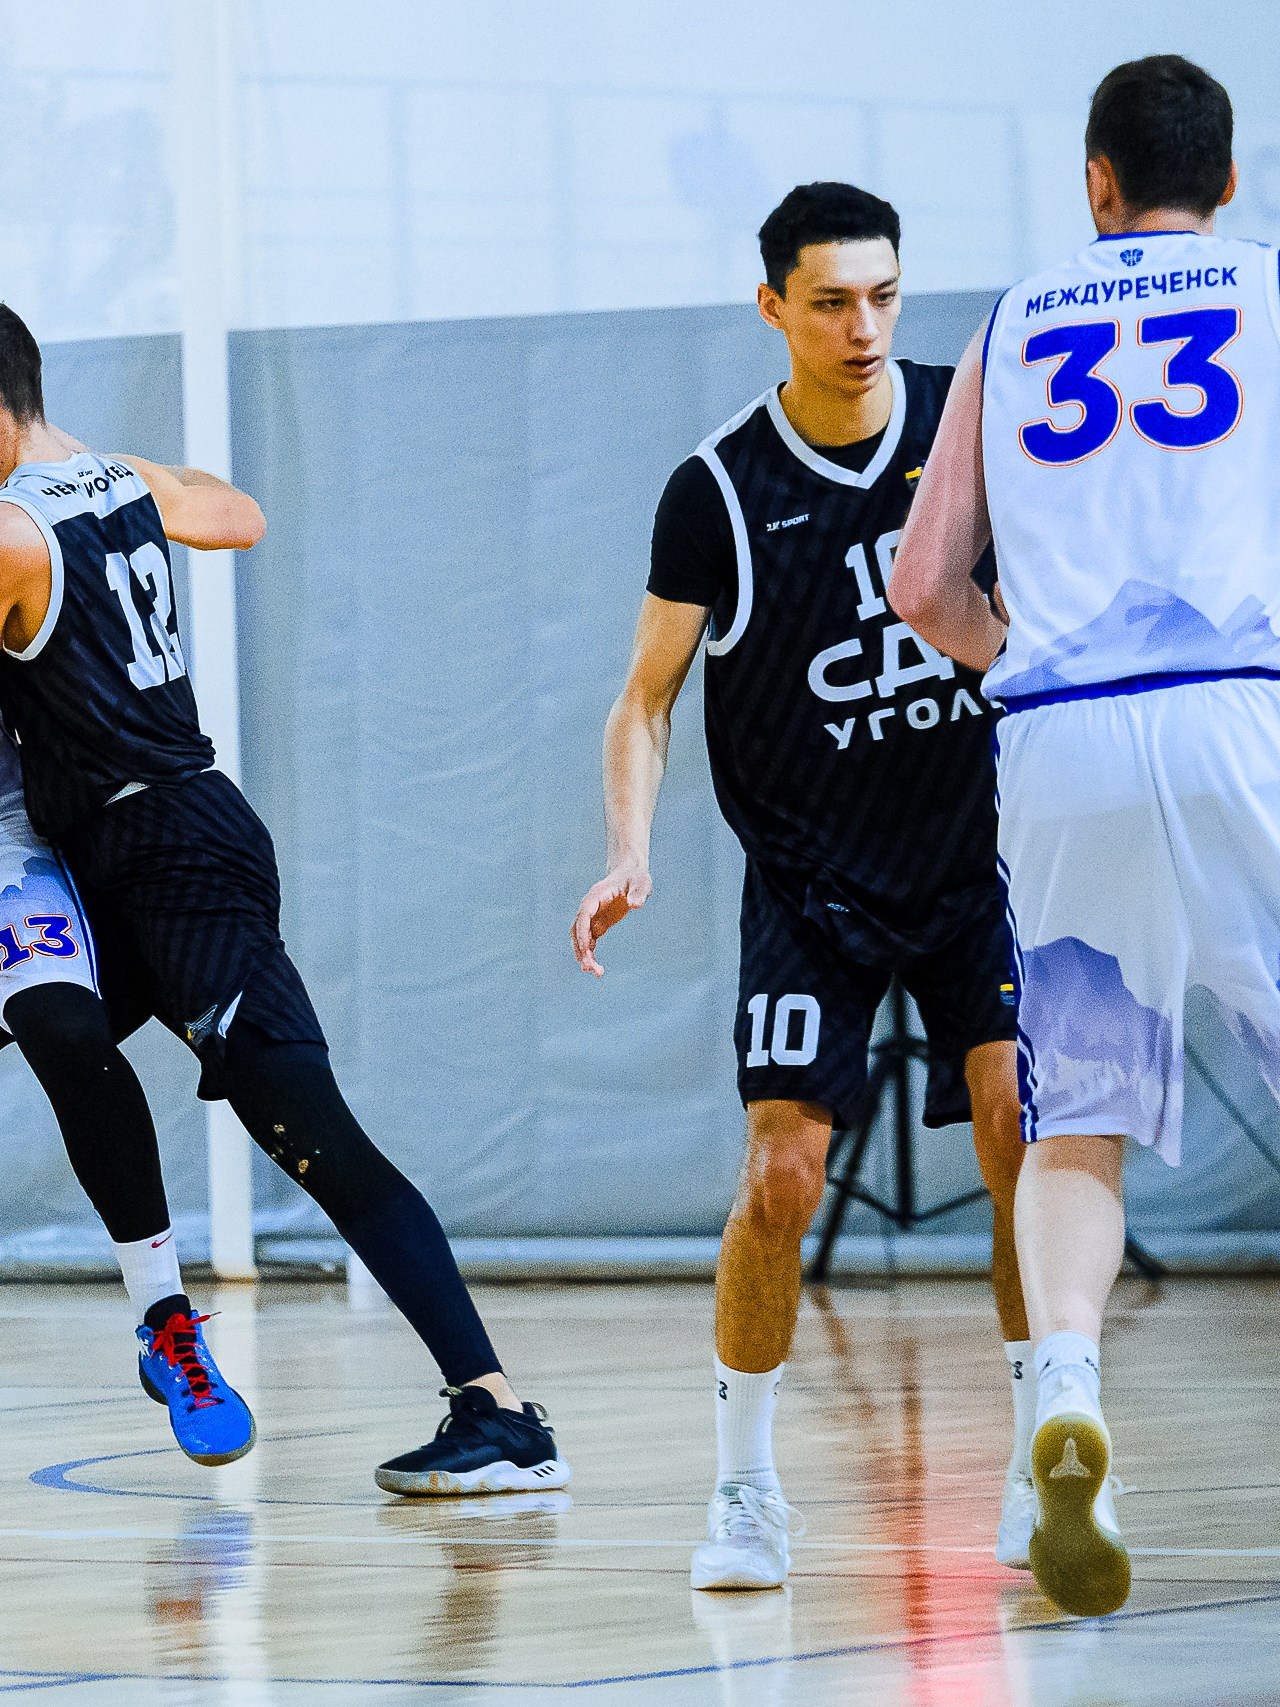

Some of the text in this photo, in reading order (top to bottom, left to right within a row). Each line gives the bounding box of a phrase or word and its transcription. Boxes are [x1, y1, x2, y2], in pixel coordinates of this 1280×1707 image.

[1025, 266, 1238, 318] МЕЖДУРЕЧЕНСК
[1018, 304, 1244, 468] 33
[105, 541, 186, 691] 12
[807, 621, 956, 703] СД
[823, 687, 1007, 750] УГОЛ
[746, 993, 821, 1068] 10
